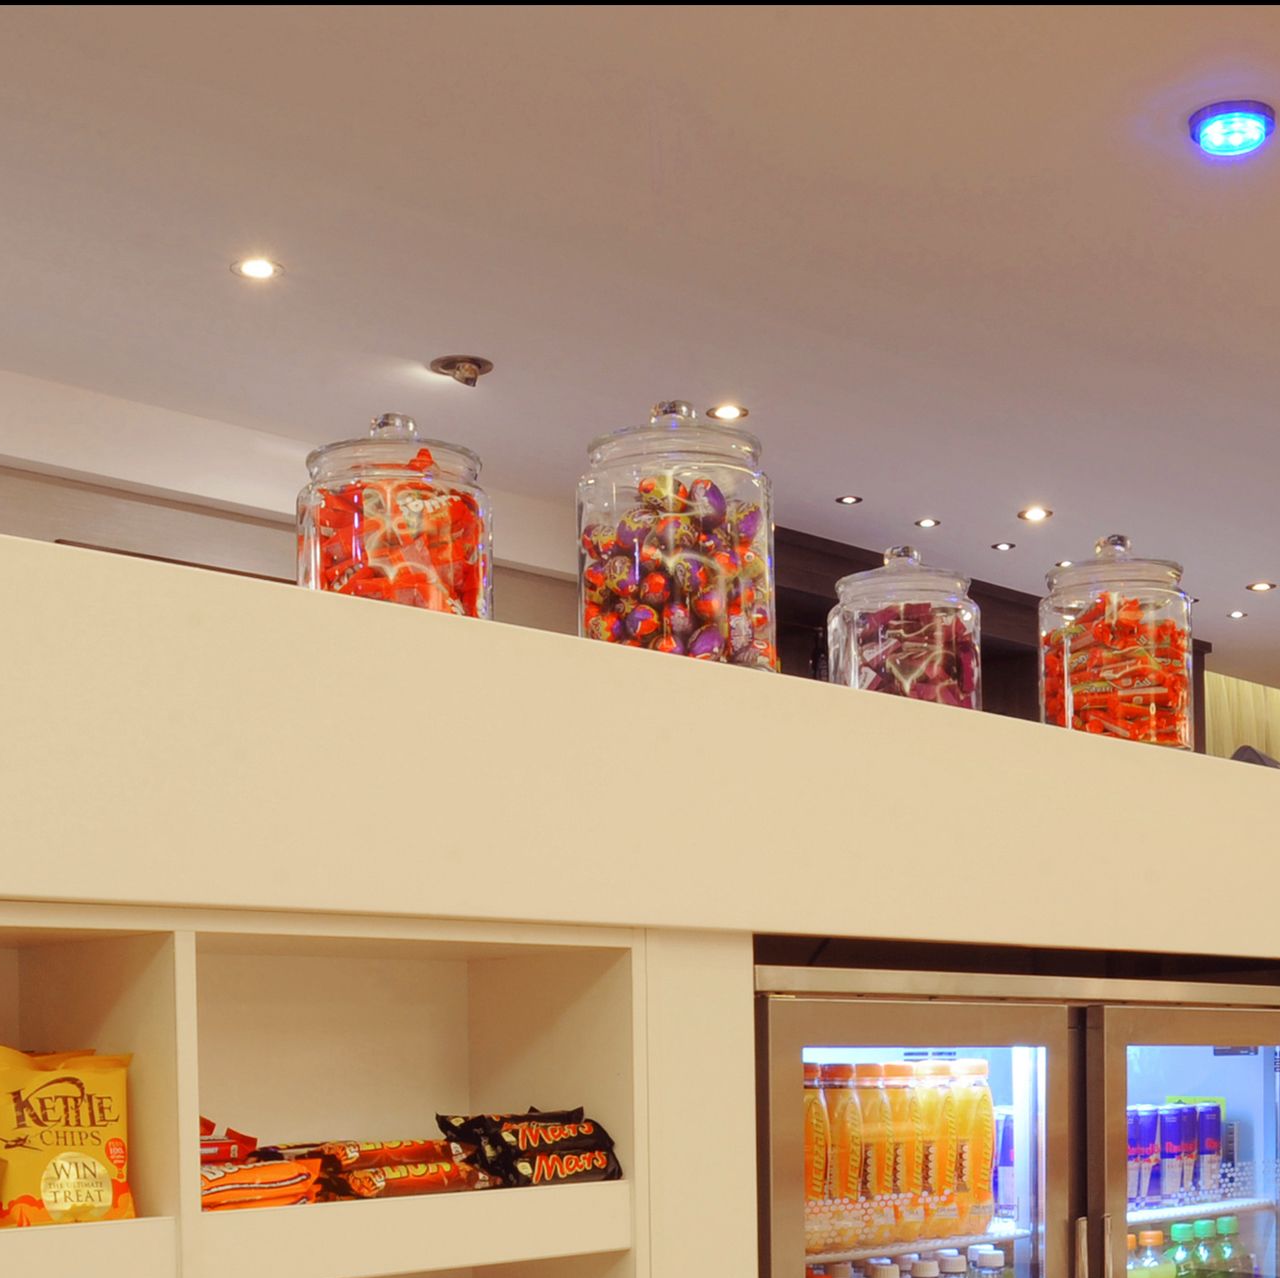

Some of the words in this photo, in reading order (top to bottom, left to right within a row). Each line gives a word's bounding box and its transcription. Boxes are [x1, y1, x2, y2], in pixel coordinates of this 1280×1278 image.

[8, 1076, 120, 1131] KETTLE
[40, 1130, 102, 1147] CHIPS
[518, 1121, 594, 1151] Mars
[53, 1161, 98, 1180] WIN
[532, 1150, 609, 1185] Mars
[50, 1189, 104, 1204] TREAT
